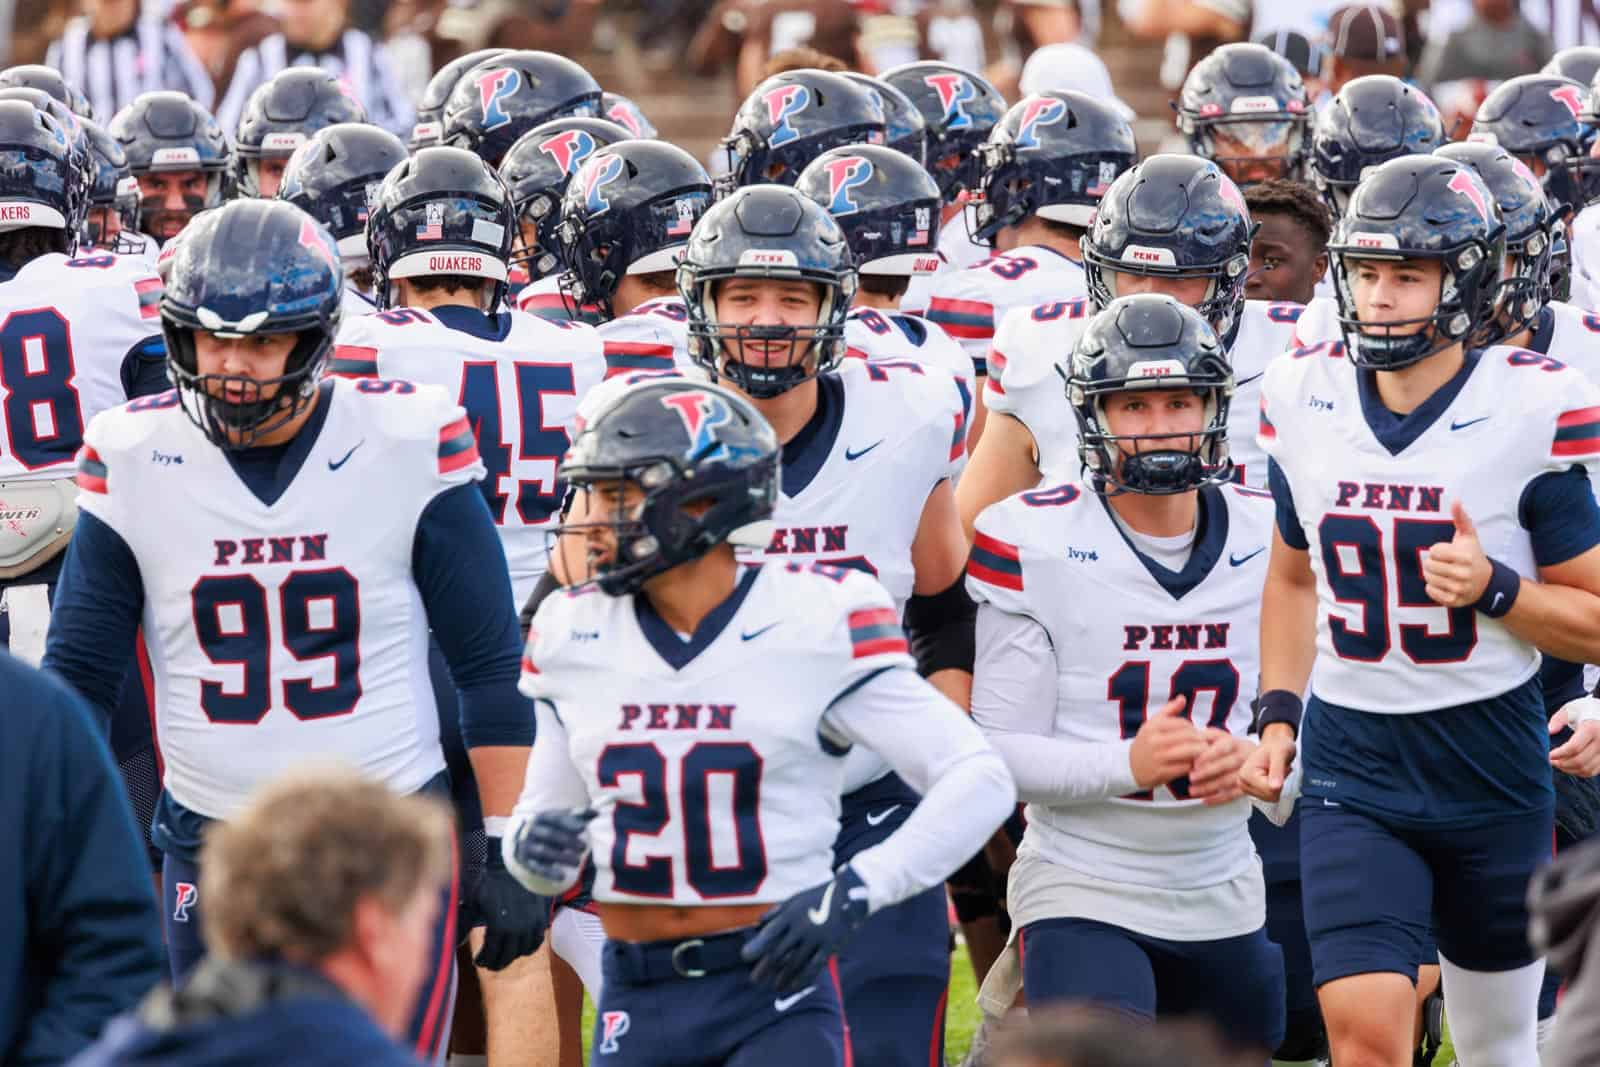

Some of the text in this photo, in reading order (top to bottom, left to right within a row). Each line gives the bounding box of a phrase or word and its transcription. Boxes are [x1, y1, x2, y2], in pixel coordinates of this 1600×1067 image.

[1133, 251, 1160, 262] PENN
[1356, 238, 1383, 248] PENN
[429, 255, 482, 271] QUAKERS
[753, 254, 783, 262] PENN
[1142, 366, 1171, 376] PENN
[1335, 481, 1444, 512] PENN
[213, 533, 328, 566] PENN
[764, 525, 848, 555] ENN
[1318, 513, 1478, 664] 95
[191, 566, 362, 724] 99
[1123, 622, 1231, 651] PENN
[618, 703, 736, 731] PENN
[597, 741, 768, 899] 20
